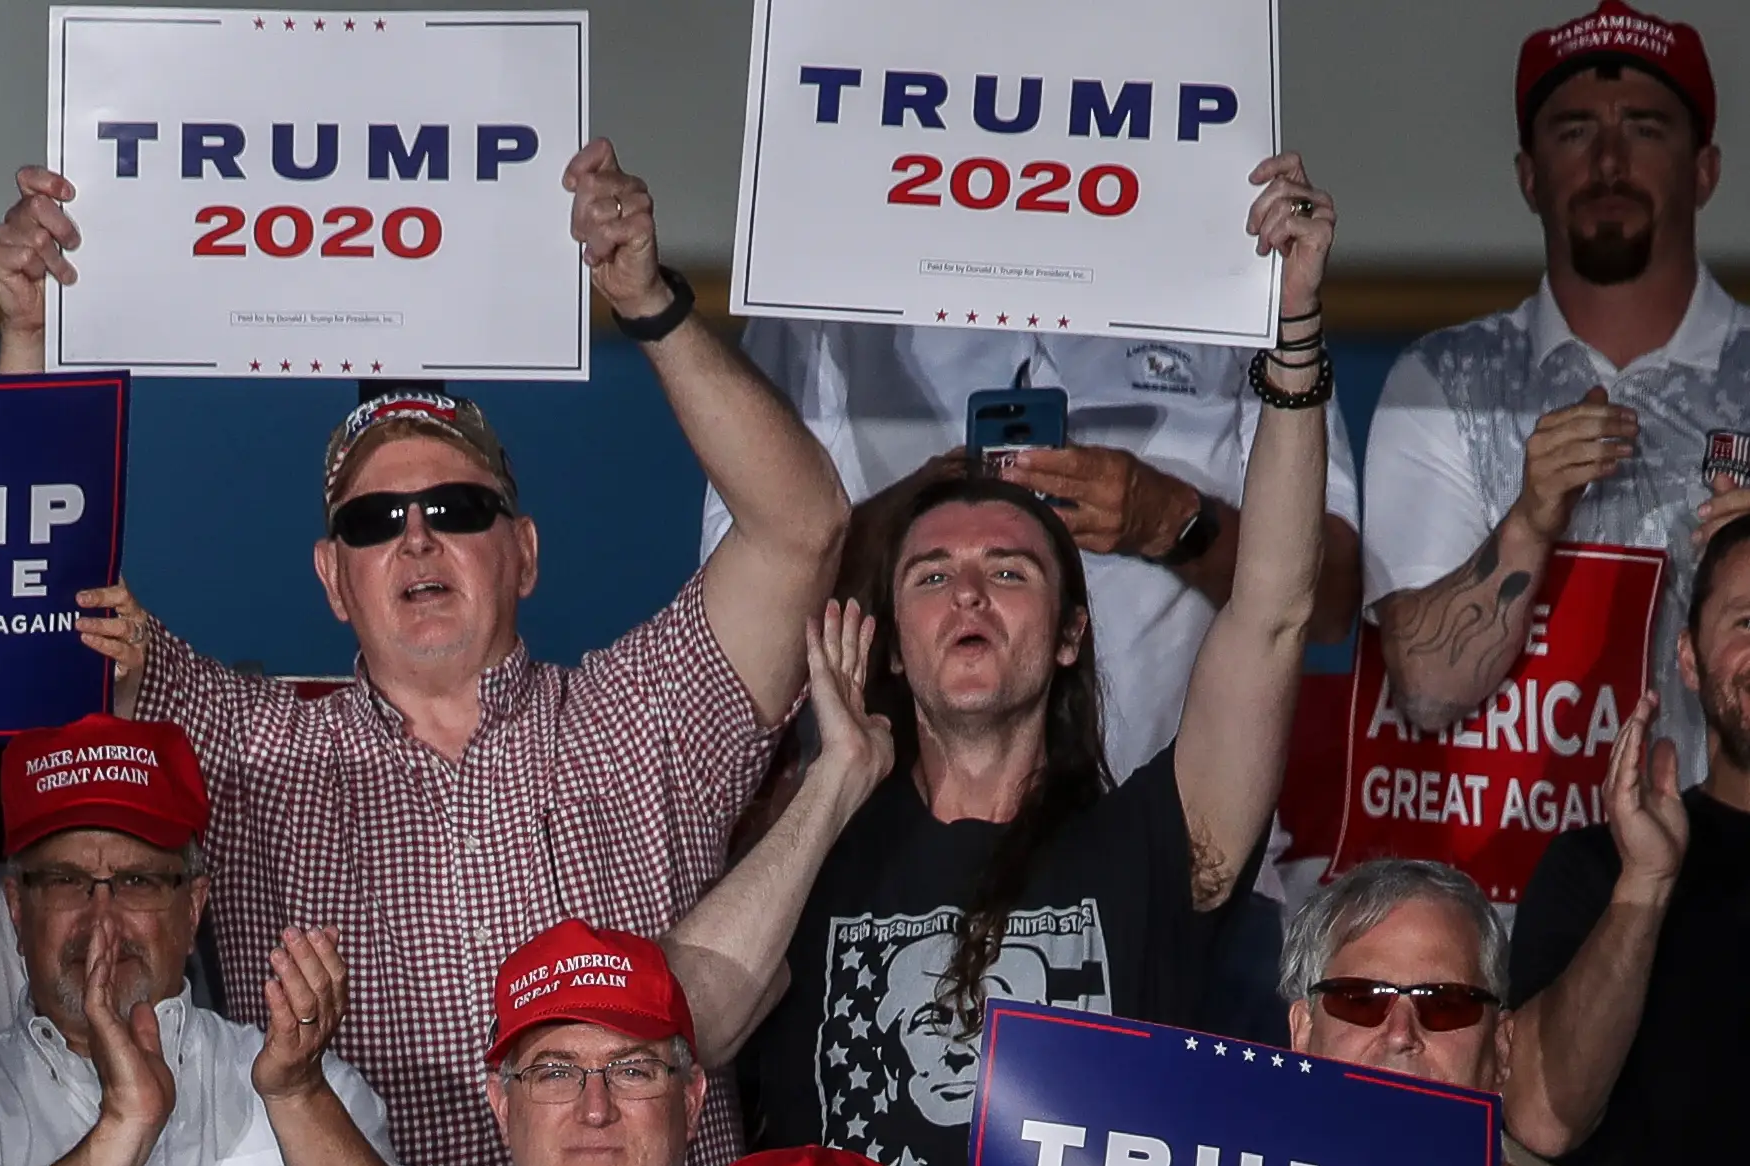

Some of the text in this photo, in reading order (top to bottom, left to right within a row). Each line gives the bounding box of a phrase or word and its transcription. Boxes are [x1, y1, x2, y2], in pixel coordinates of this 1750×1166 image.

[800, 66, 1238, 142] TRUMP
[98, 122, 539, 181] TRUMP
[887, 154, 1139, 217] 2020
[193, 205, 443, 258] 2020
[26, 745, 158, 776] MAKE AMERICA
[37, 766, 149, 793] GREAT AGAIN
[1362, 765, 1608, 834] GREAT AGAI
[839, 920, 870, 943] 45th
[873, 917, 948, 943] RESIDENT
[509, 954, 633, 996] MAKE AMERICA
[514, 973, 626, 1009] GREAT AGAIN
